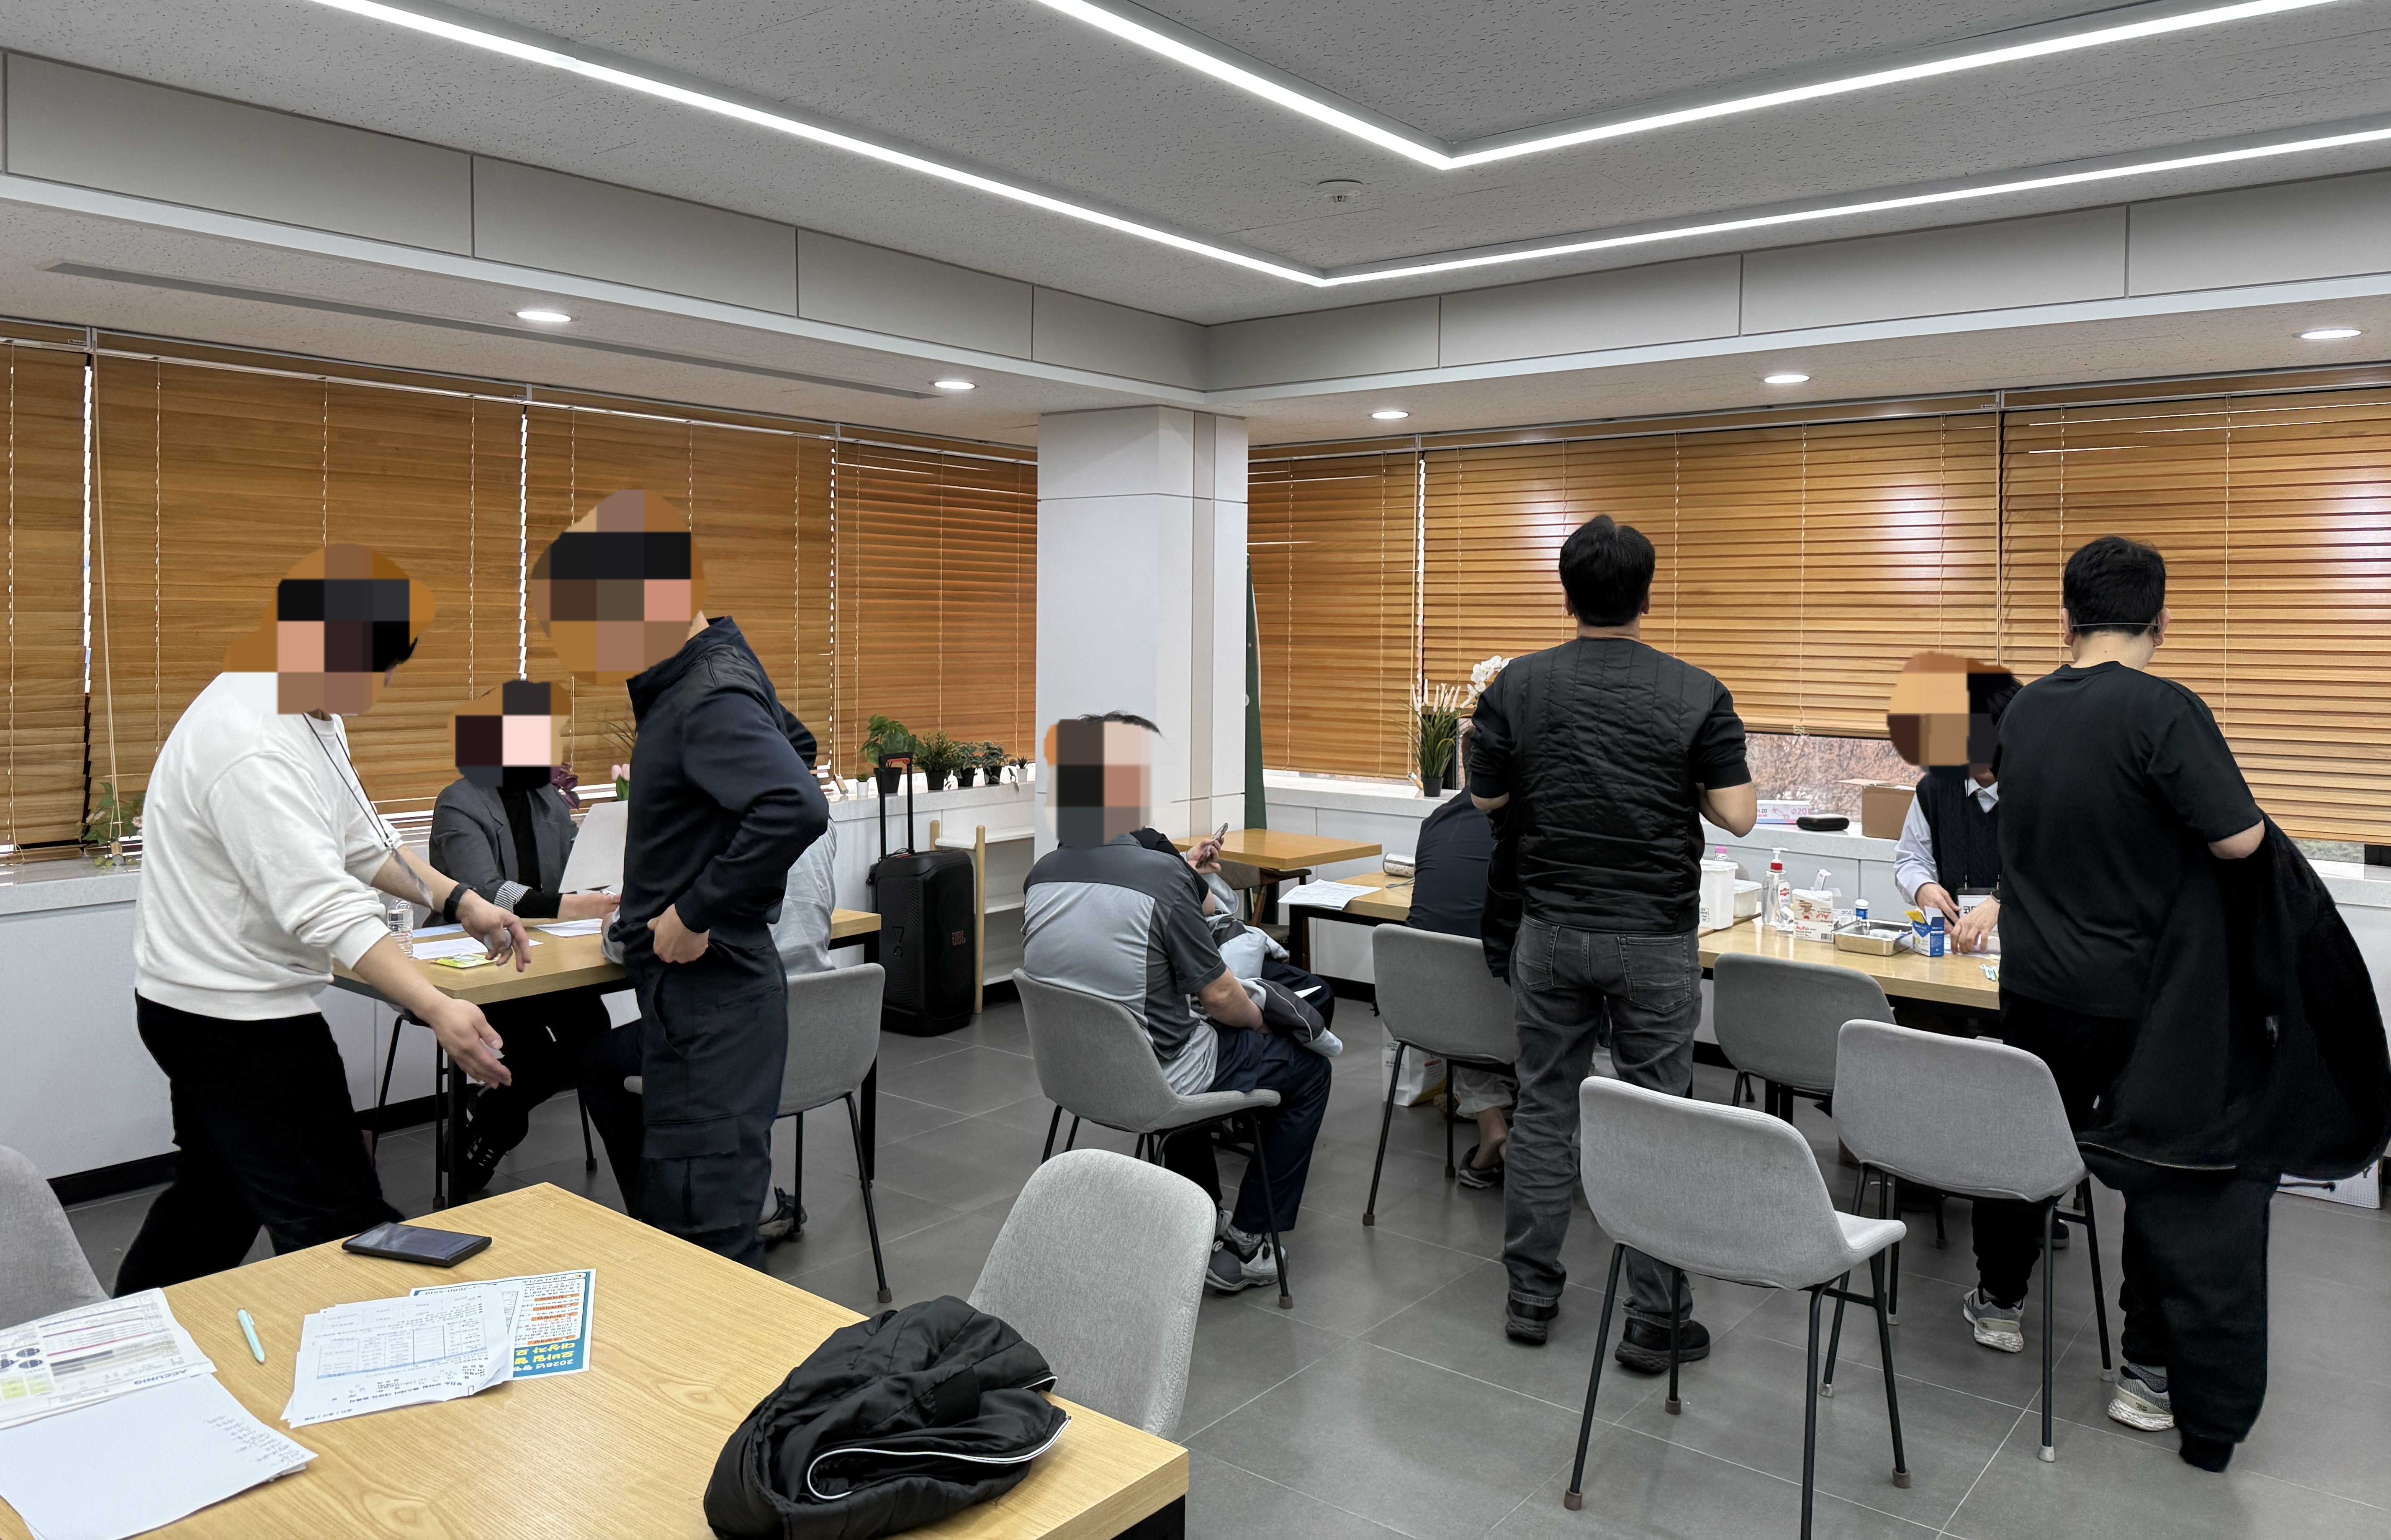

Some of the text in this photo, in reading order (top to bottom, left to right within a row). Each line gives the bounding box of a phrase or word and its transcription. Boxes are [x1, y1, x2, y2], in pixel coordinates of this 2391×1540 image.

[952, 930, 966, 946] JBL
[532, 1342, 575, 1354] 대상자
[533, 1350, 575, 1363] 모바일
[535, 1359, 574, 1369] 2026년
[134, 1369, 187, 1384] ACCUNIQ
